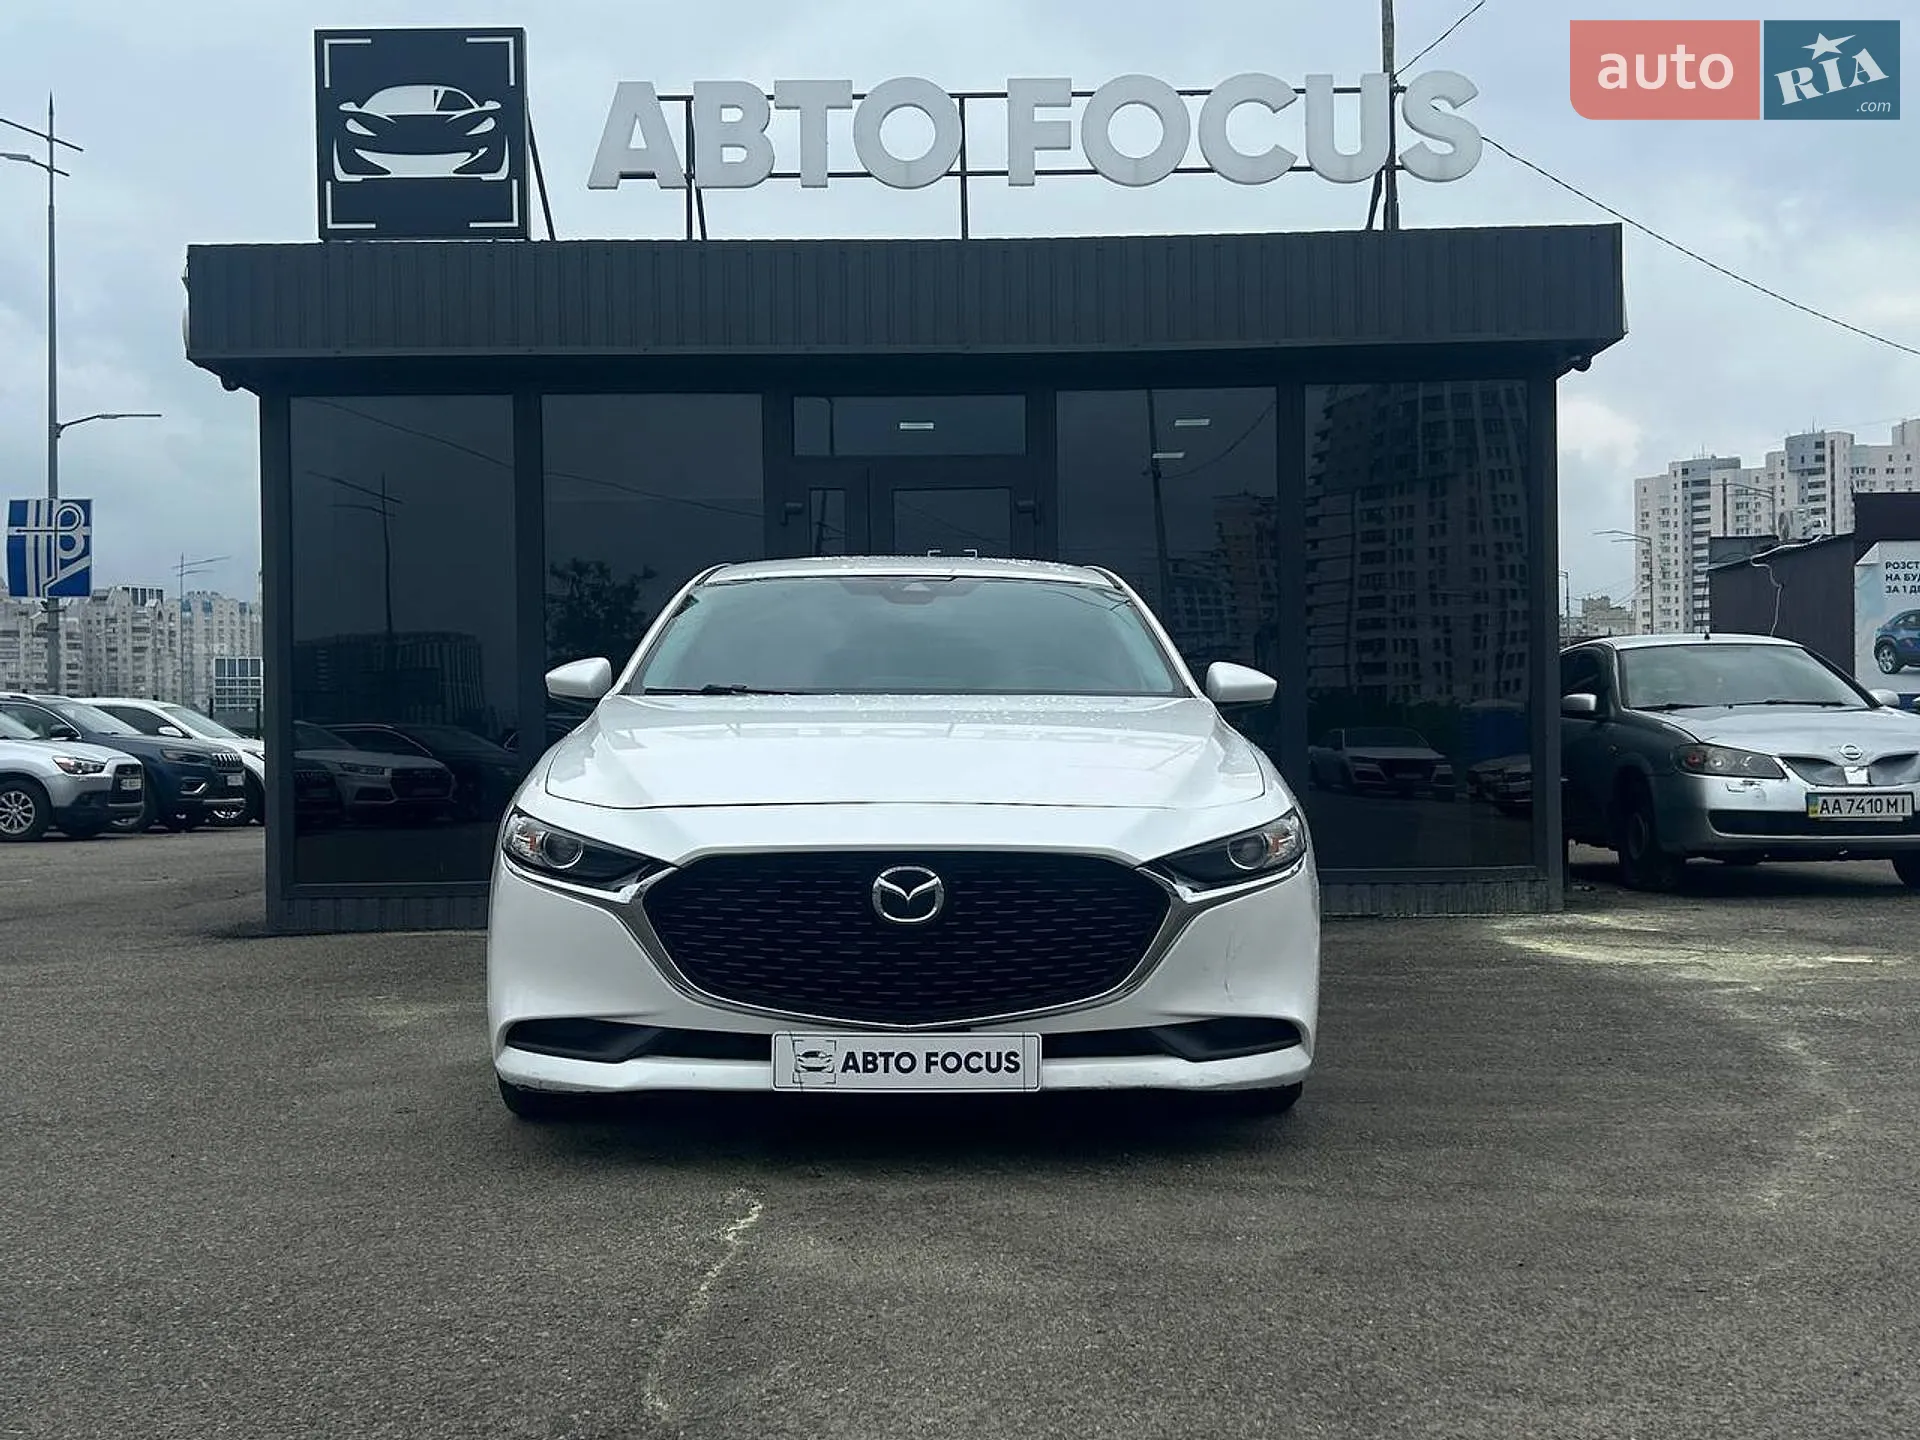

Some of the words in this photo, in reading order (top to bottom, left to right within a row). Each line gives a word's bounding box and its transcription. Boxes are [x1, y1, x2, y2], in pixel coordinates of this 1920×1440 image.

[588, 77, 962, 188] АВТО
[1007, 70, 1483, 187] FOCUS
[1885, 573, 1901, 582] НА
[841, 1051, 917, 1074] АВТО
[925, 1051, 1021, 1074] FOCUS
